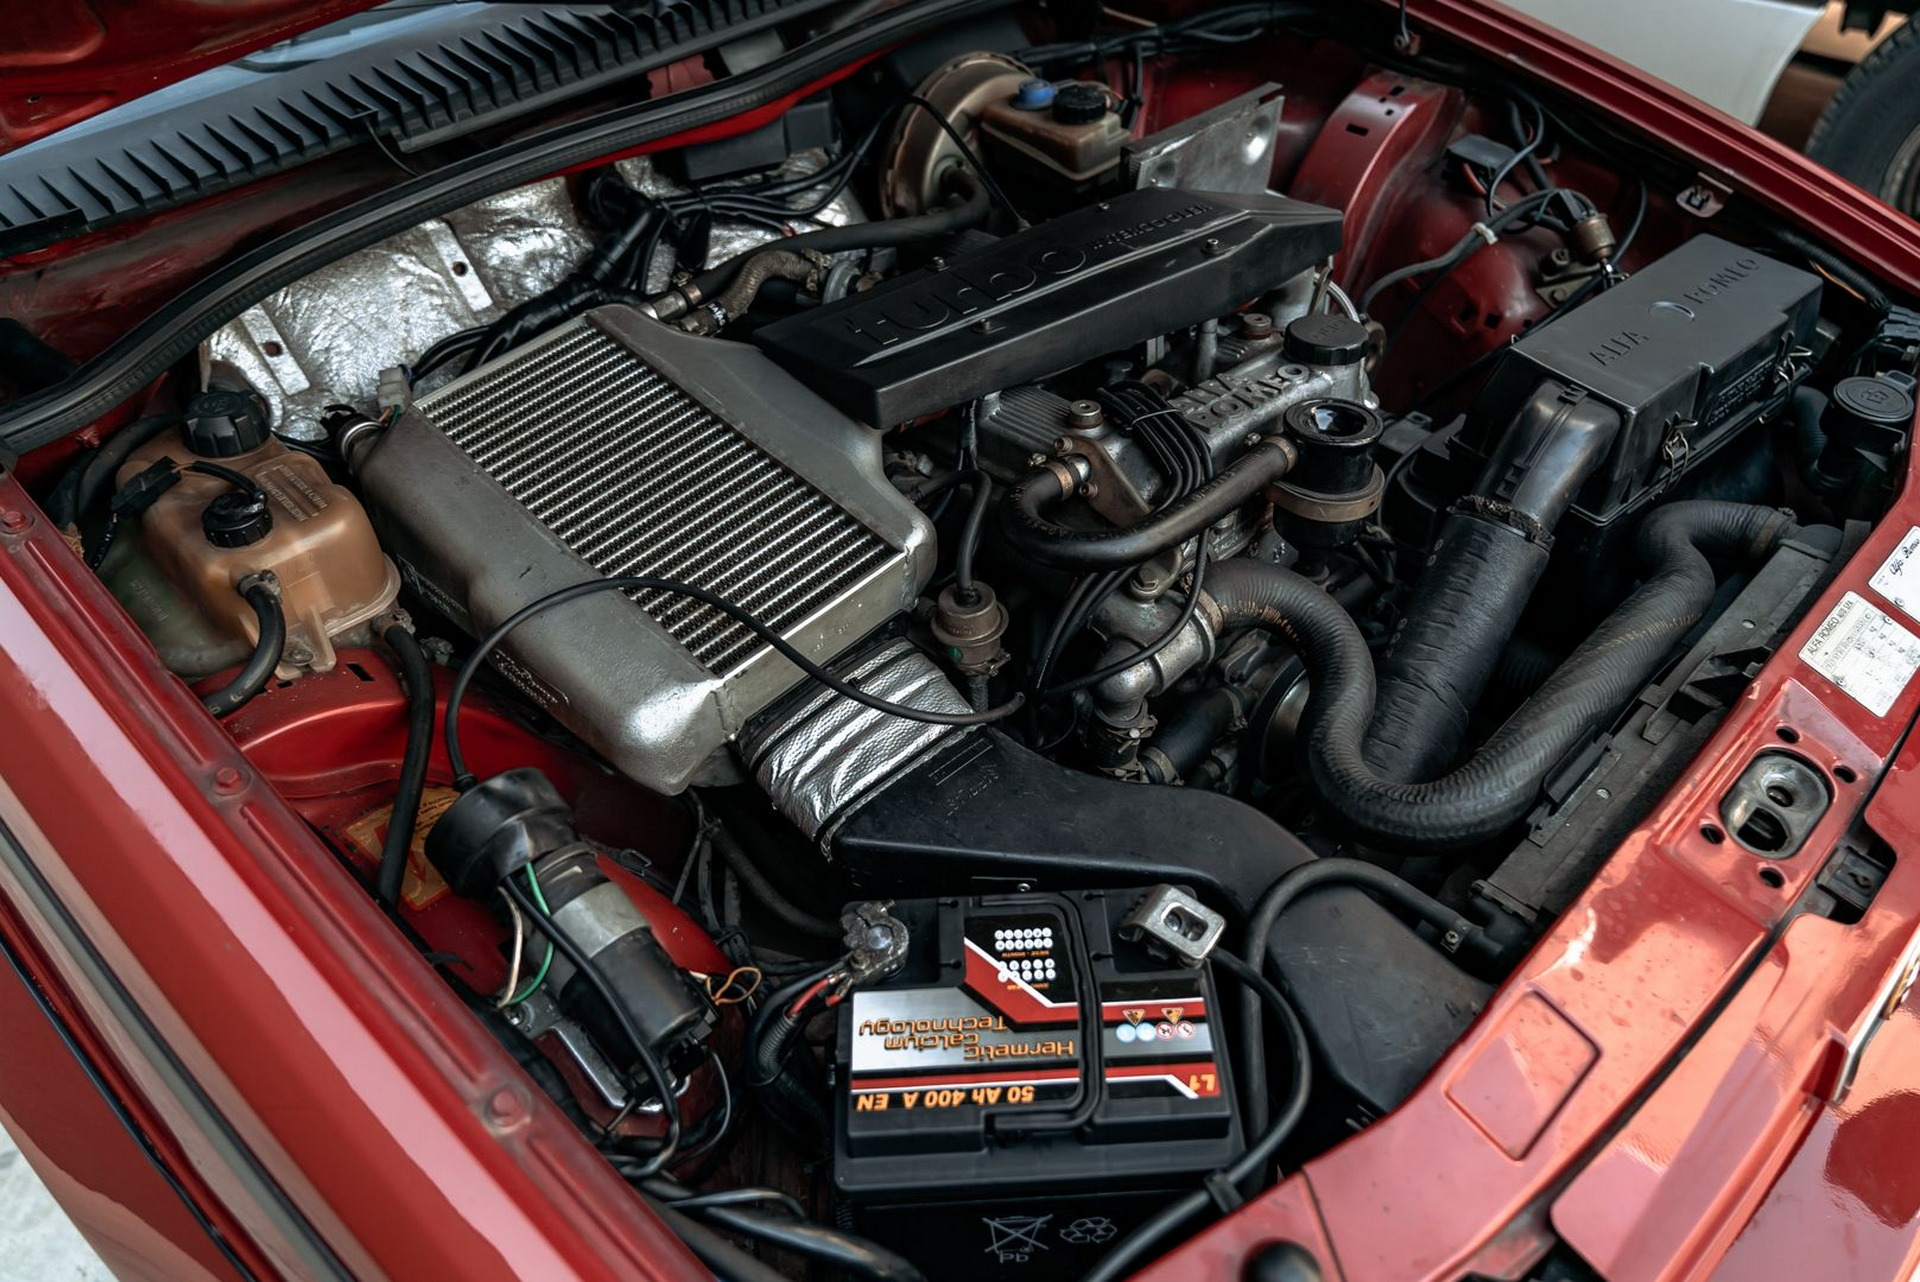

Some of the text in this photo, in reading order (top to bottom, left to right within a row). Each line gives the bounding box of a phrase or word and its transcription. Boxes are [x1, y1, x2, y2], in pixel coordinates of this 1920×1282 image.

[1683, 258, 1760, 304] ROMEO
[1806, 638, 1823, 656] ALFA
[1818, 616, 1840, 641] ROMEO
[859, 1015, 1008, 1036] Technology
[884, 1032, 981, 1052] Calcium
[963, 1040, 1075, 1062] Hermetic
[1188, 1073, 1217, 1092] L1
[855, 1085, 1036, 1112] 50 Ah 400 A EN
[998, 1250, 1031, 1264] Pb
